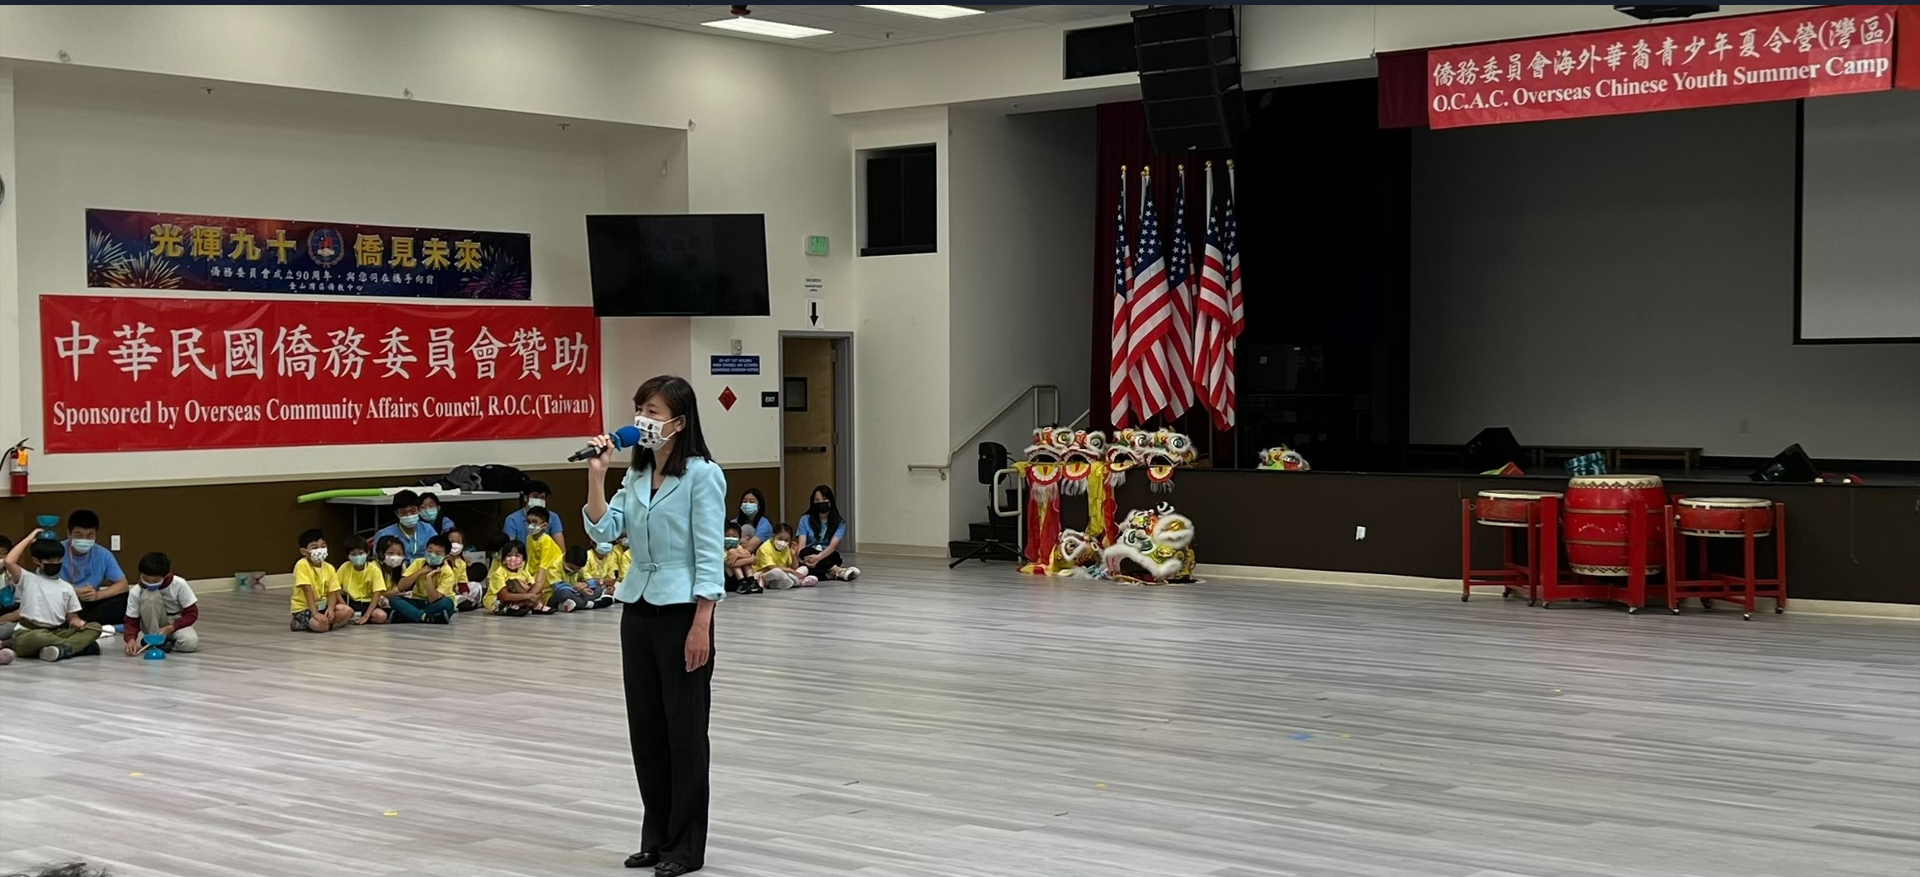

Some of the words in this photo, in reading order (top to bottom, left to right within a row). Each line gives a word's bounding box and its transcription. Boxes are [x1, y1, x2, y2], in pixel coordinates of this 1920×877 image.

[1432, 89, 1509, 112] O.C.A.C.
[1512, 85, 1591, 106] Overseas
[1595, 78, 1668, 98] Chinese
[1672, 69, 1728, 91] Youth
[1733, 63, 1821, 86] Summer
[1825, 56, 1889, 78] Camp
[150, 223, 297, 265] 光輝九十
[353, 233, 482, 271] 僑見未來
[54, 319, 590, 383] 中華民國僑務委員會贊助
[53, 400, 152, 432] Sponsored
[157, 399, 180, 429] by
[184, 399, 262, 423] Overseas
[266, 397, 363, 425] Community
[366, 396, 419, 420] Affairs
[422, 395, 484, 421] Council,
[487, 393, 595, 419] R.O.C.(Taiwan)
